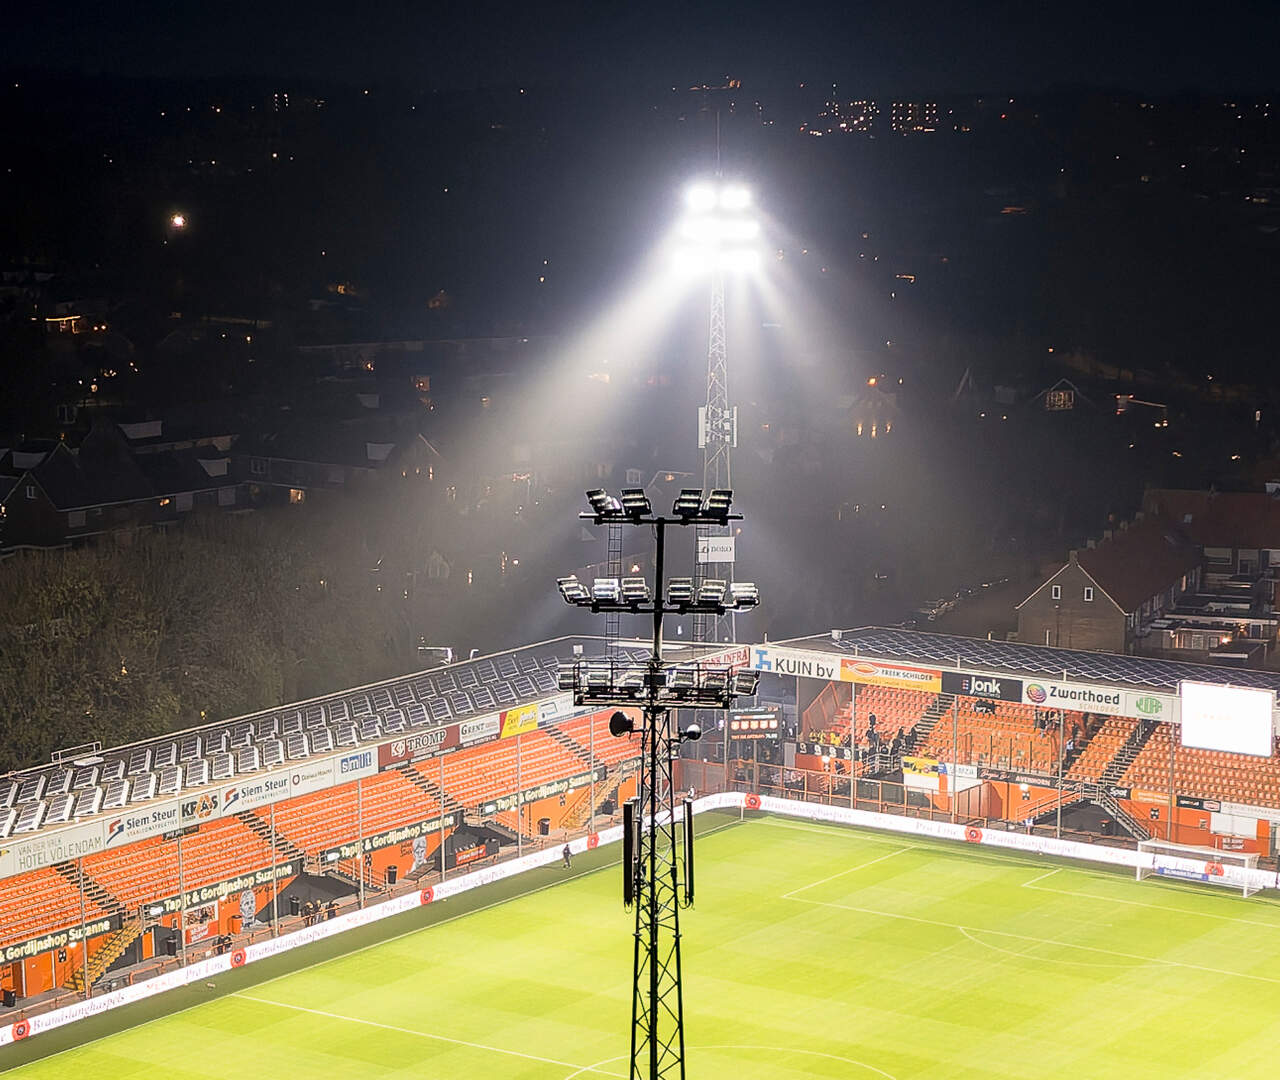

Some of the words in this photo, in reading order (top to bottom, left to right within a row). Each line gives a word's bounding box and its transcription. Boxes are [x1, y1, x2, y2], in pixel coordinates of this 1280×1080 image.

[775, 658, 812, 676] KUIN
[816, 664, 834, 678] bv
[902, 672, 933, 681] SCHILDER
[969, 676, 1001, 694] Jonk
[1049, 685, 1120, 705] Zwarthoed
[407, 729, 447, 752] TROMP
[241, 783, 263, 798] Siem
[264, 777, 288, 792] Steur
[181, 795, 219, 817] KRAS
[126, 815, 150, 830] Siem
[152, 808, 177, 823] Steur
[372, 827, 420, 847] Gordijnshop
[19, 852, 48, 869] HOTEL
[52, 837, 102, 862] VOLENDAM
[201, 877, 255, 897] Gordijnshop
[6, 934, 67, 960] Gordijnshop
